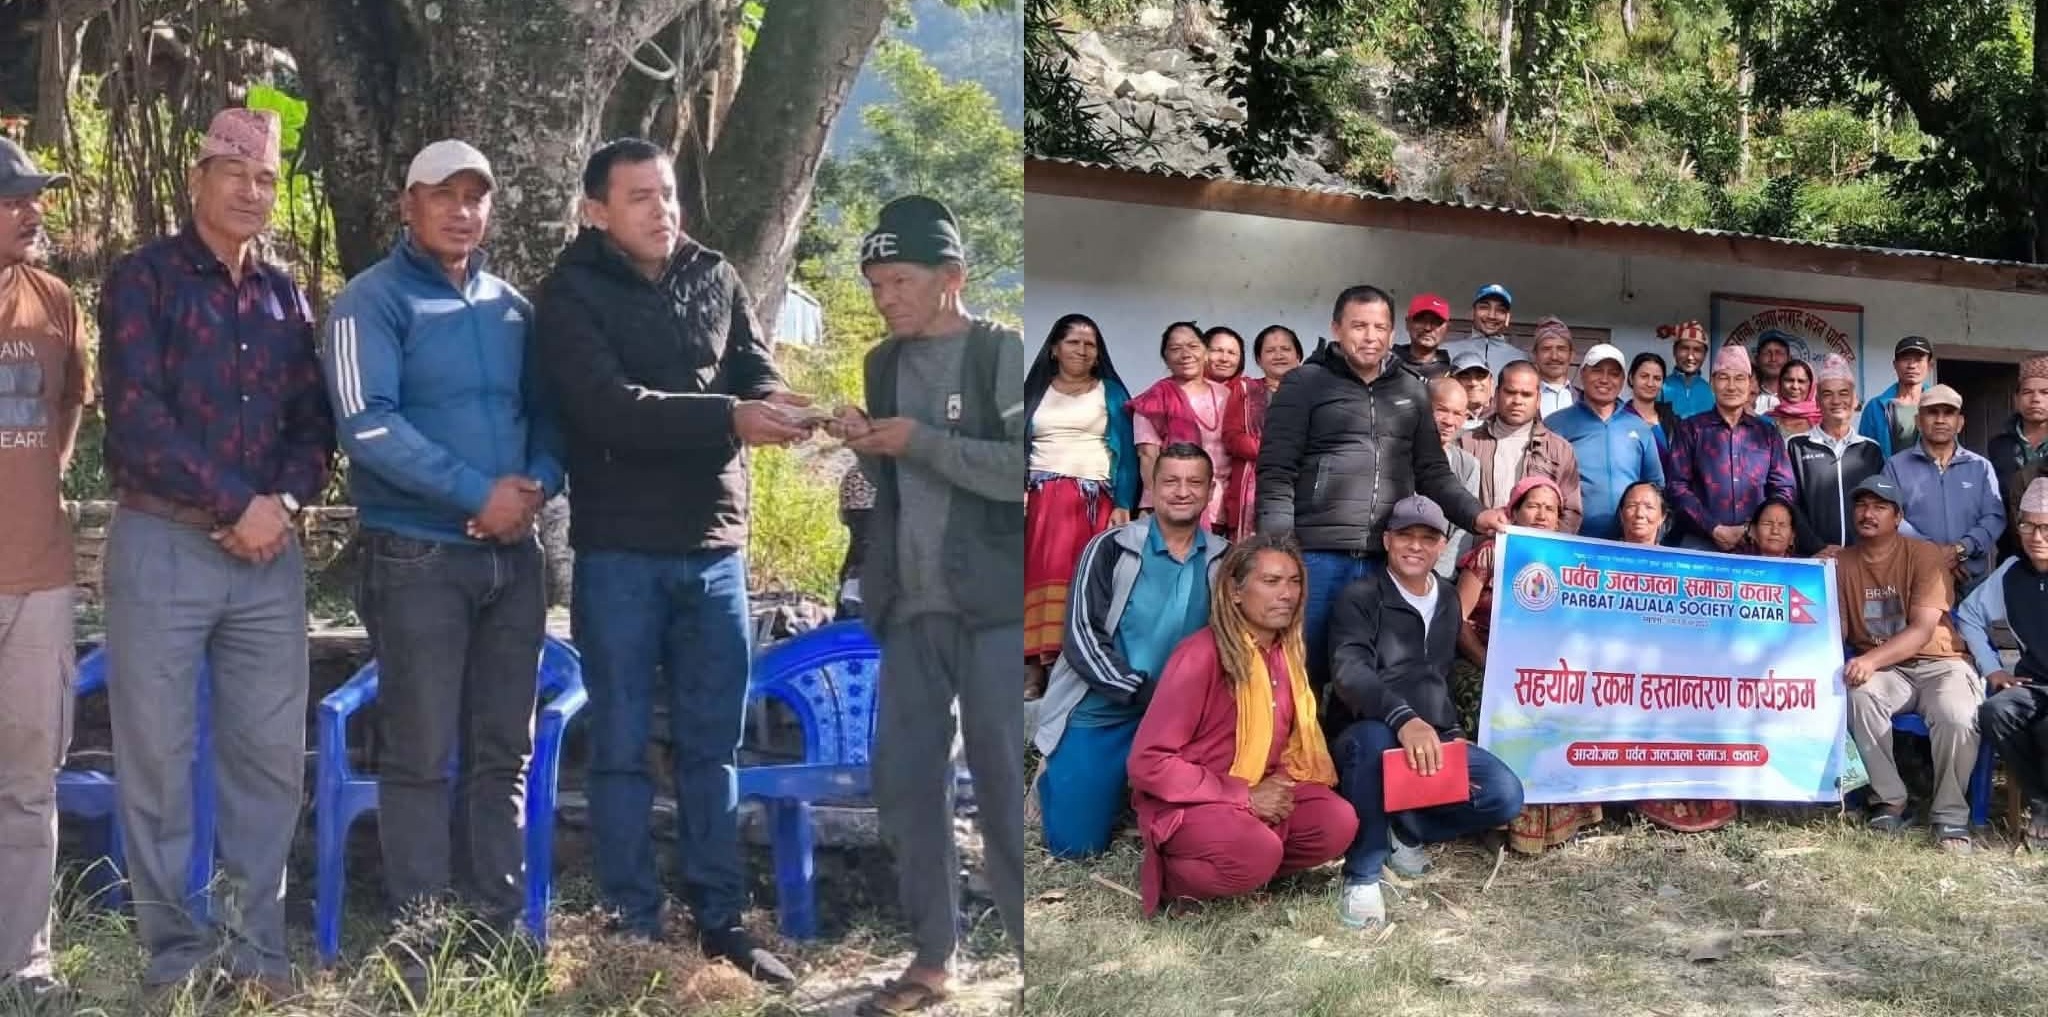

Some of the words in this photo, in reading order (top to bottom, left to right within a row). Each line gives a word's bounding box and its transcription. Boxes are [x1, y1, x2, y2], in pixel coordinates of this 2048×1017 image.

[1561, 562, 1599, 589] पर्वत
[1605, 571, 1678, 595] जलजला
[1684, 577, 1734, 600] समाज
[1739, 582, 1784, 604] कतार
[1561, 592, 1614, 609] PARBAT
[1619, 596, 1674, 613] JALJALA
[1680, 600, 1734, 617] SOCIETY
[1739, 605, 1784, 620] QATAR
[1514, 658, 1587, 707] सहयोग
[1592, 671, 1635, 707] रकम
[1640, 674, 1732, 711] हस्तान्तरण
[1737, 669, 1816, 711] कार्यक्रम
[1625, 745, 1647, 761] पर्वत
[1650, 749, 1693, 761] जलजला
